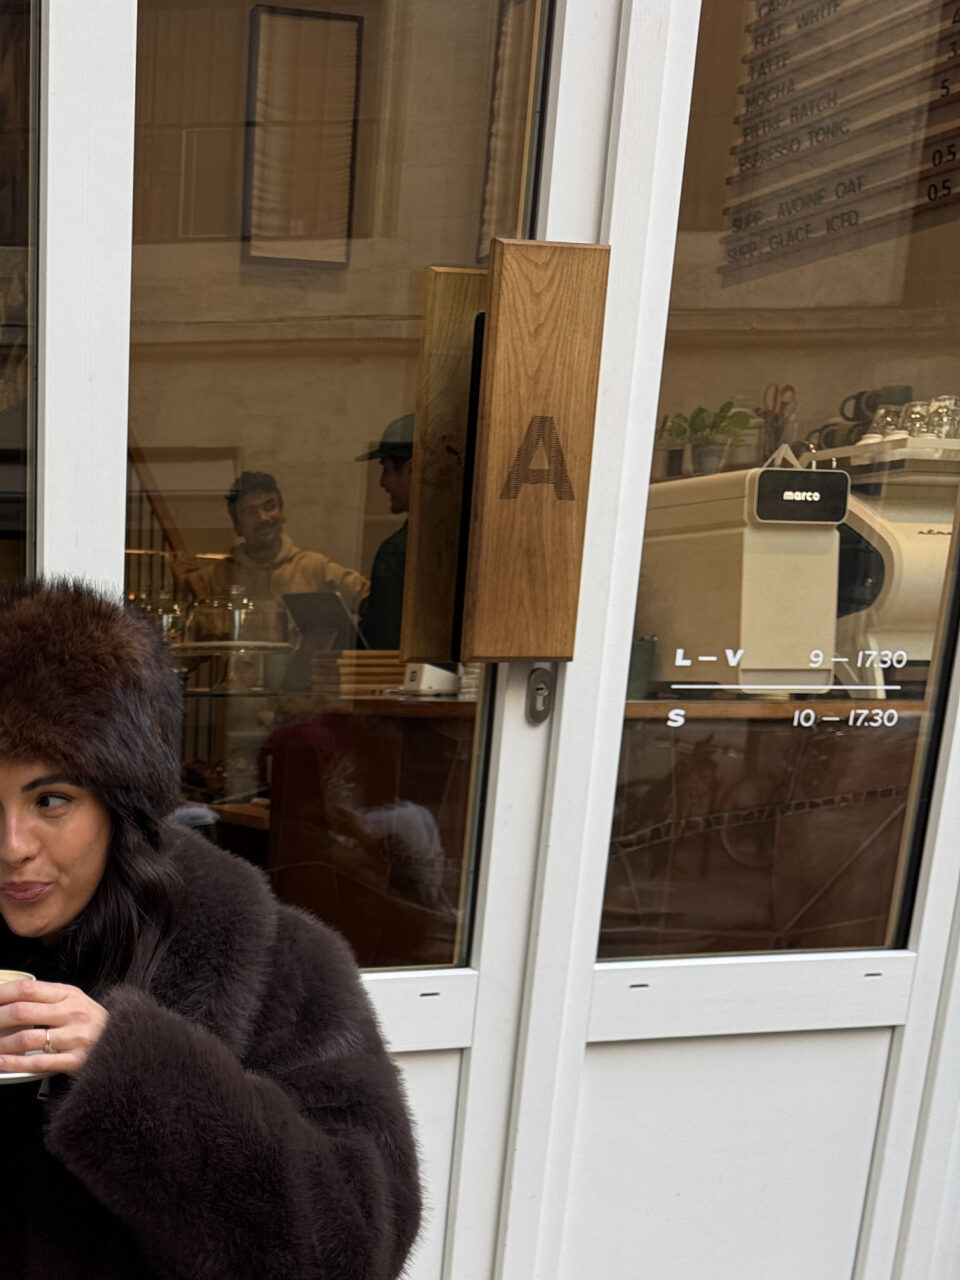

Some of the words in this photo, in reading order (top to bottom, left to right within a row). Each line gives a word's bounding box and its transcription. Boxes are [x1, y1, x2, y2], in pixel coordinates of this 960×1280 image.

[745, 79, 796, 112] MOCHA
[941, 79, 950, 98] 5
[835, 175, 866, 199] OAT
[932, 144, 957, 167] 0.5
[927, 179, 951, 201] 0.5
[498, 415, 576, 501] A
[783, 491, 821, 502] marco
[857, 650, 908, 668] 17.30
[666, 709, 686, 727] S
[848, 709, 898, 727] 17.30
